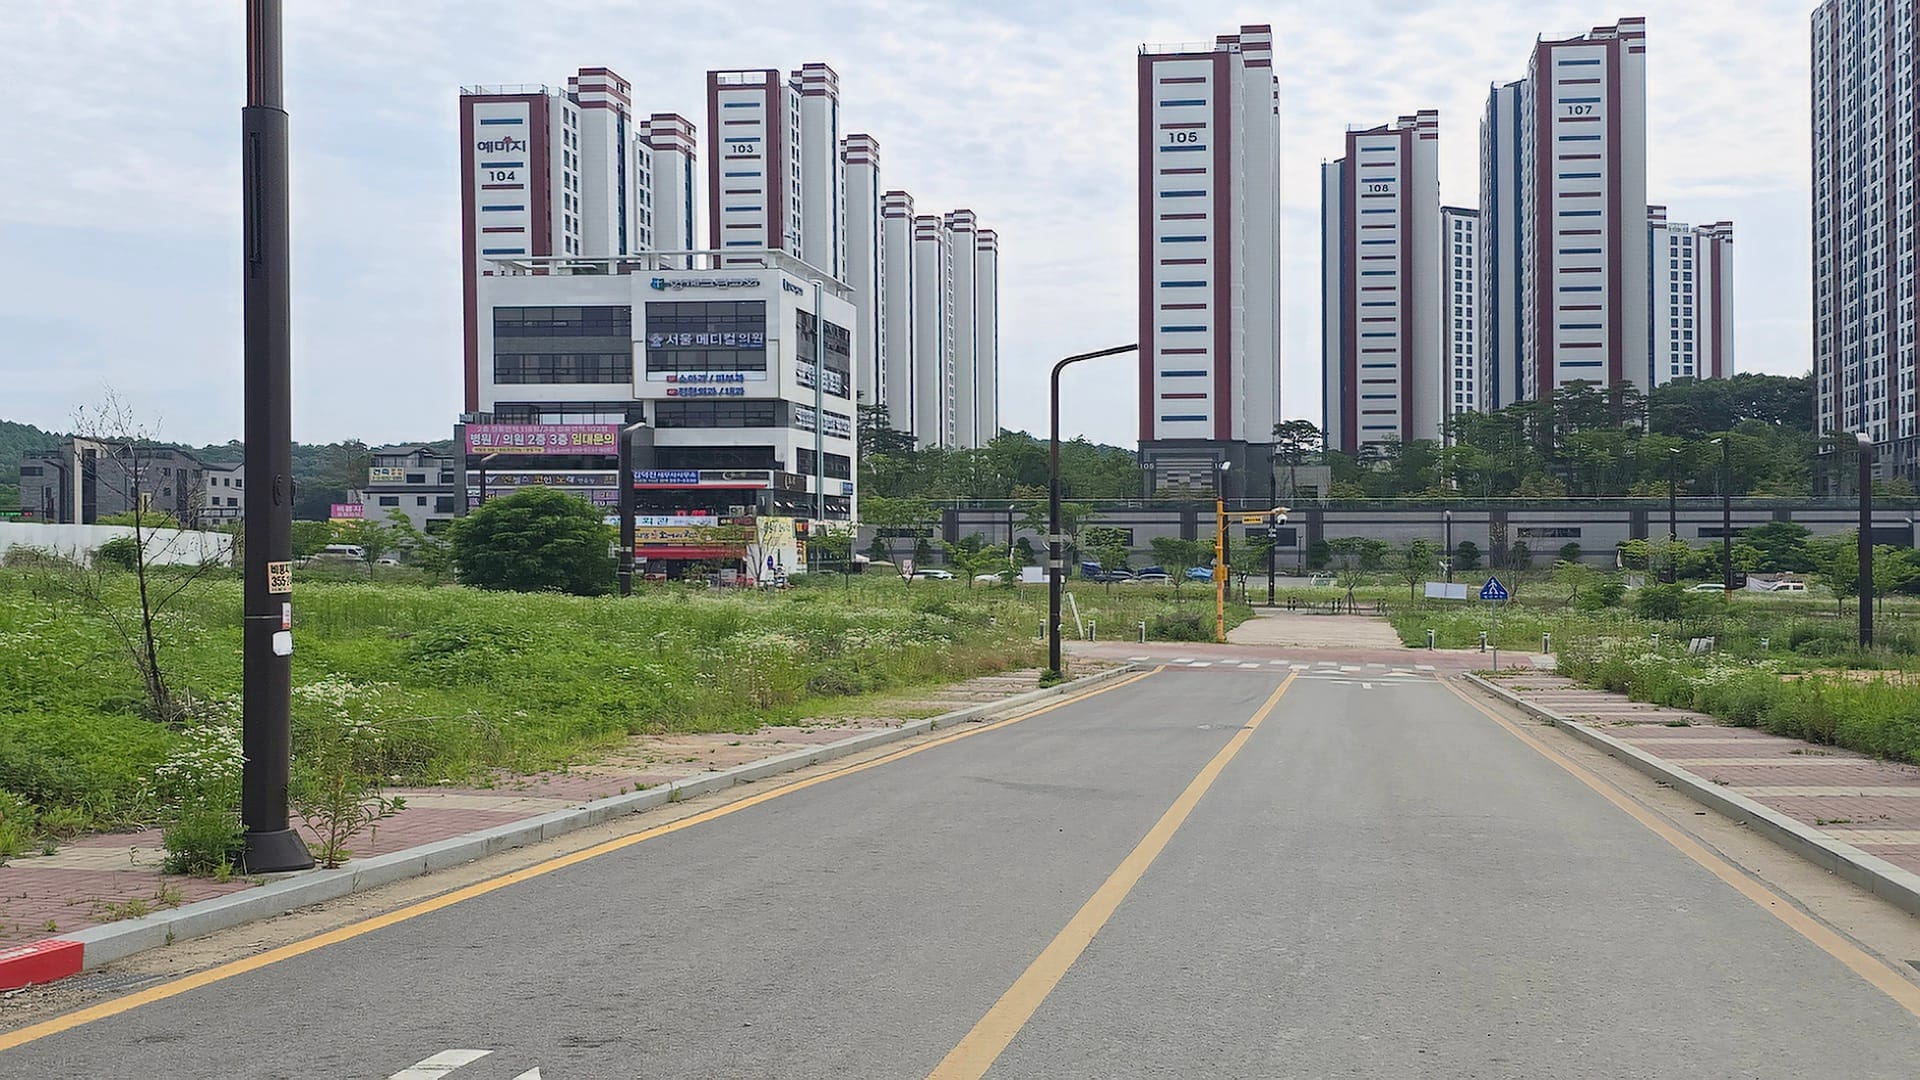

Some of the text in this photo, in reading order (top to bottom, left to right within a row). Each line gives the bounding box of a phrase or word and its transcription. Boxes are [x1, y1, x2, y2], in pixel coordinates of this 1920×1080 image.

[1568, 105, 1592, 115] 107
[1169, 132, 1198, 143] 105
[477, 140, 526, 153] 예미지
[732, 144, 754, 153] 103
[489, 171, 515, 181] 104
[1368, 184, 1389, 192] 108
[666, 333, 764, 347] 서울 메디컬 의원
[470, 433, 492, 446] 병원
[503, 433, 525, 446] 의원
[528, 433, 546, 446] 2층
[550, 433, 569, 446] 3층
[571, 433, 615, 446] 임대문의
